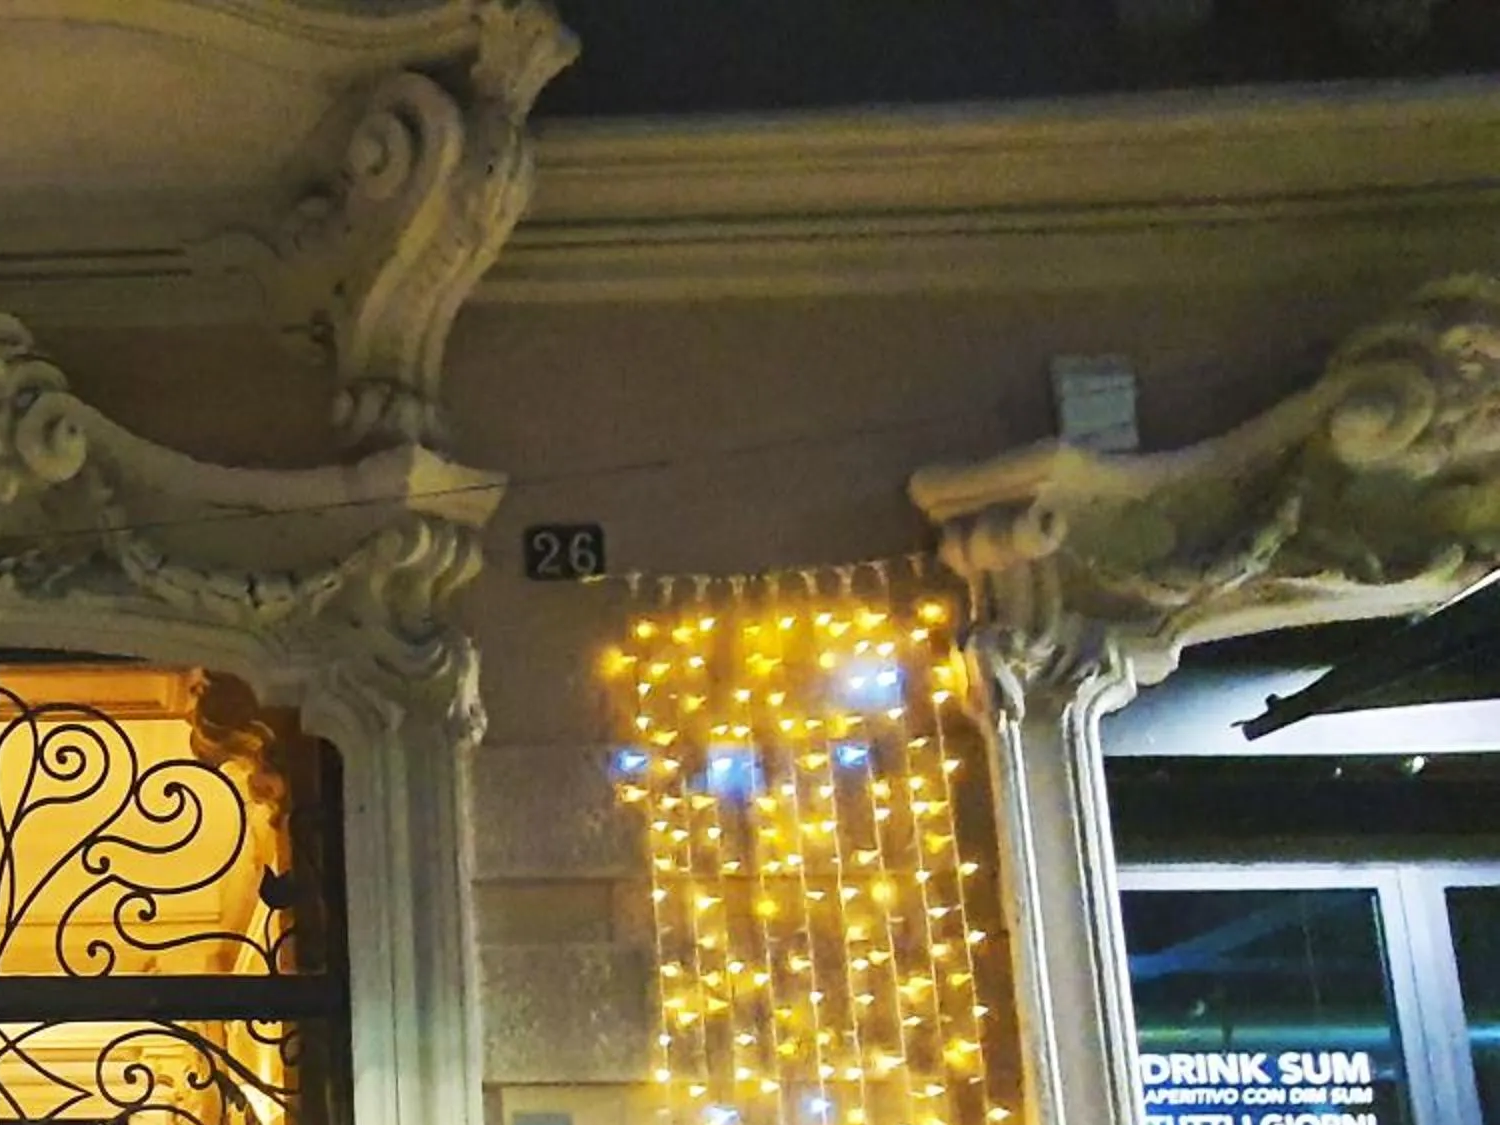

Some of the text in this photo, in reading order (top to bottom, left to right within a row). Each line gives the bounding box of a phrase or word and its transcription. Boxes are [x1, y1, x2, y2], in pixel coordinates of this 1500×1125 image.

[533, 532, 596, 574] 26
[1140, 1052, 1371, 1085] DRINK SUM
[1145, 1086, 1374, 1105] APERITIVO CON DIM SUM
